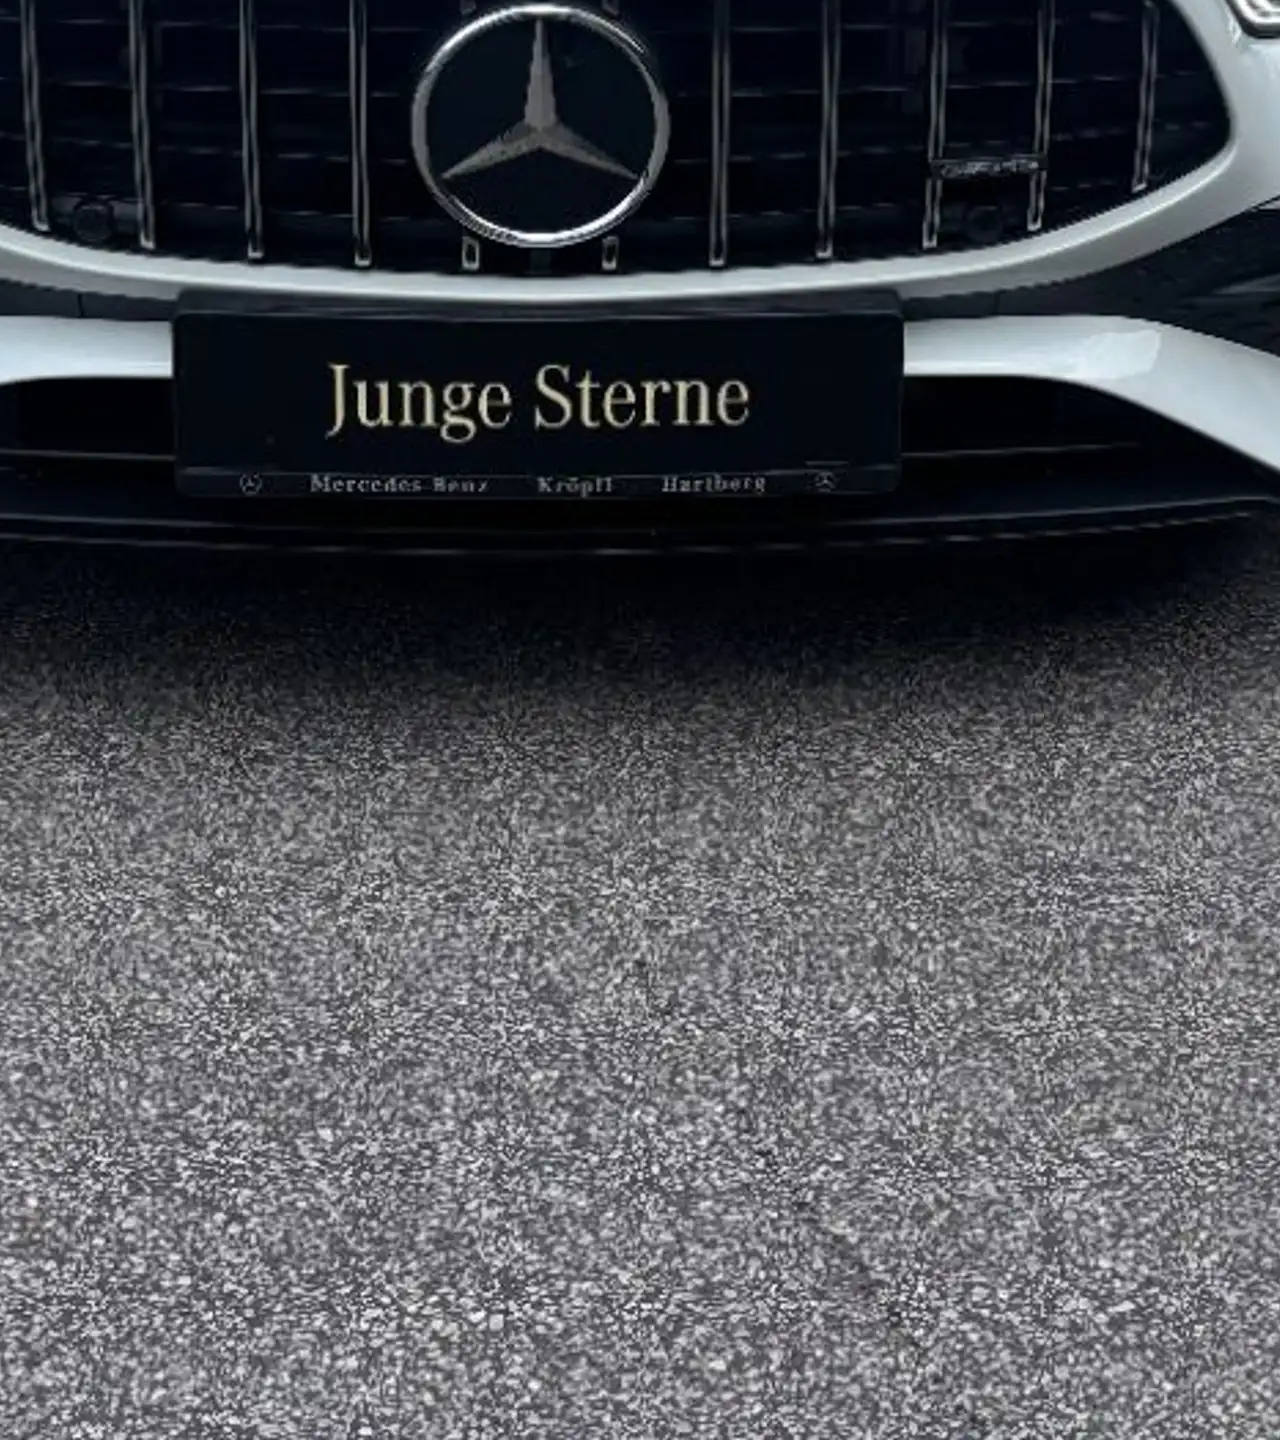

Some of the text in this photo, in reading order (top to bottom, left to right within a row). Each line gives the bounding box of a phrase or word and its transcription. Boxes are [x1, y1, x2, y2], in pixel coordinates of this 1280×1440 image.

[326, 363, 750, 443] Junge Sterne
[660, 472, 767, 496] Hartberg
